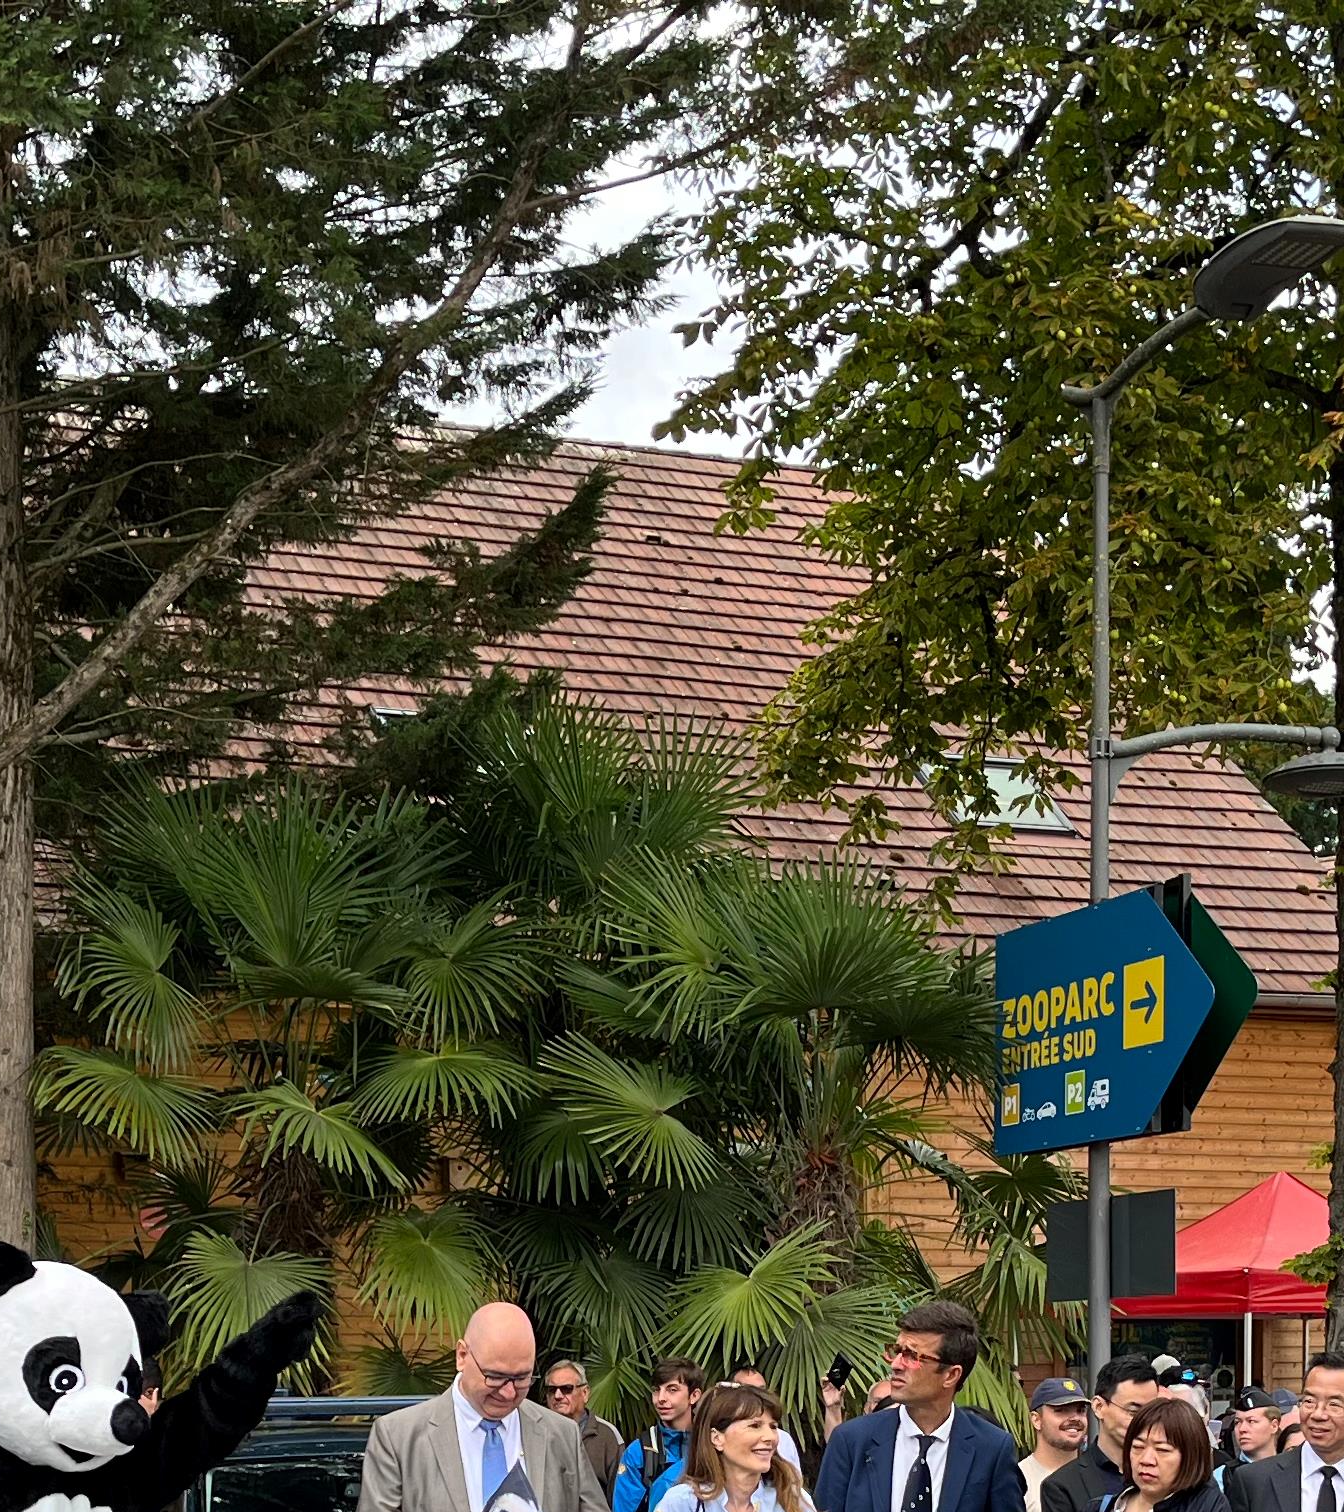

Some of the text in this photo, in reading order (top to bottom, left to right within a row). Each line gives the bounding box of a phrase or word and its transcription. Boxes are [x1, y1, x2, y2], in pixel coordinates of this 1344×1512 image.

[1002, 971, 1115, 1039] ZOOPARC
[1063, 1028, 1096, 1062] SUD
[1004, 1082, 1083, 1116] P1 P2
